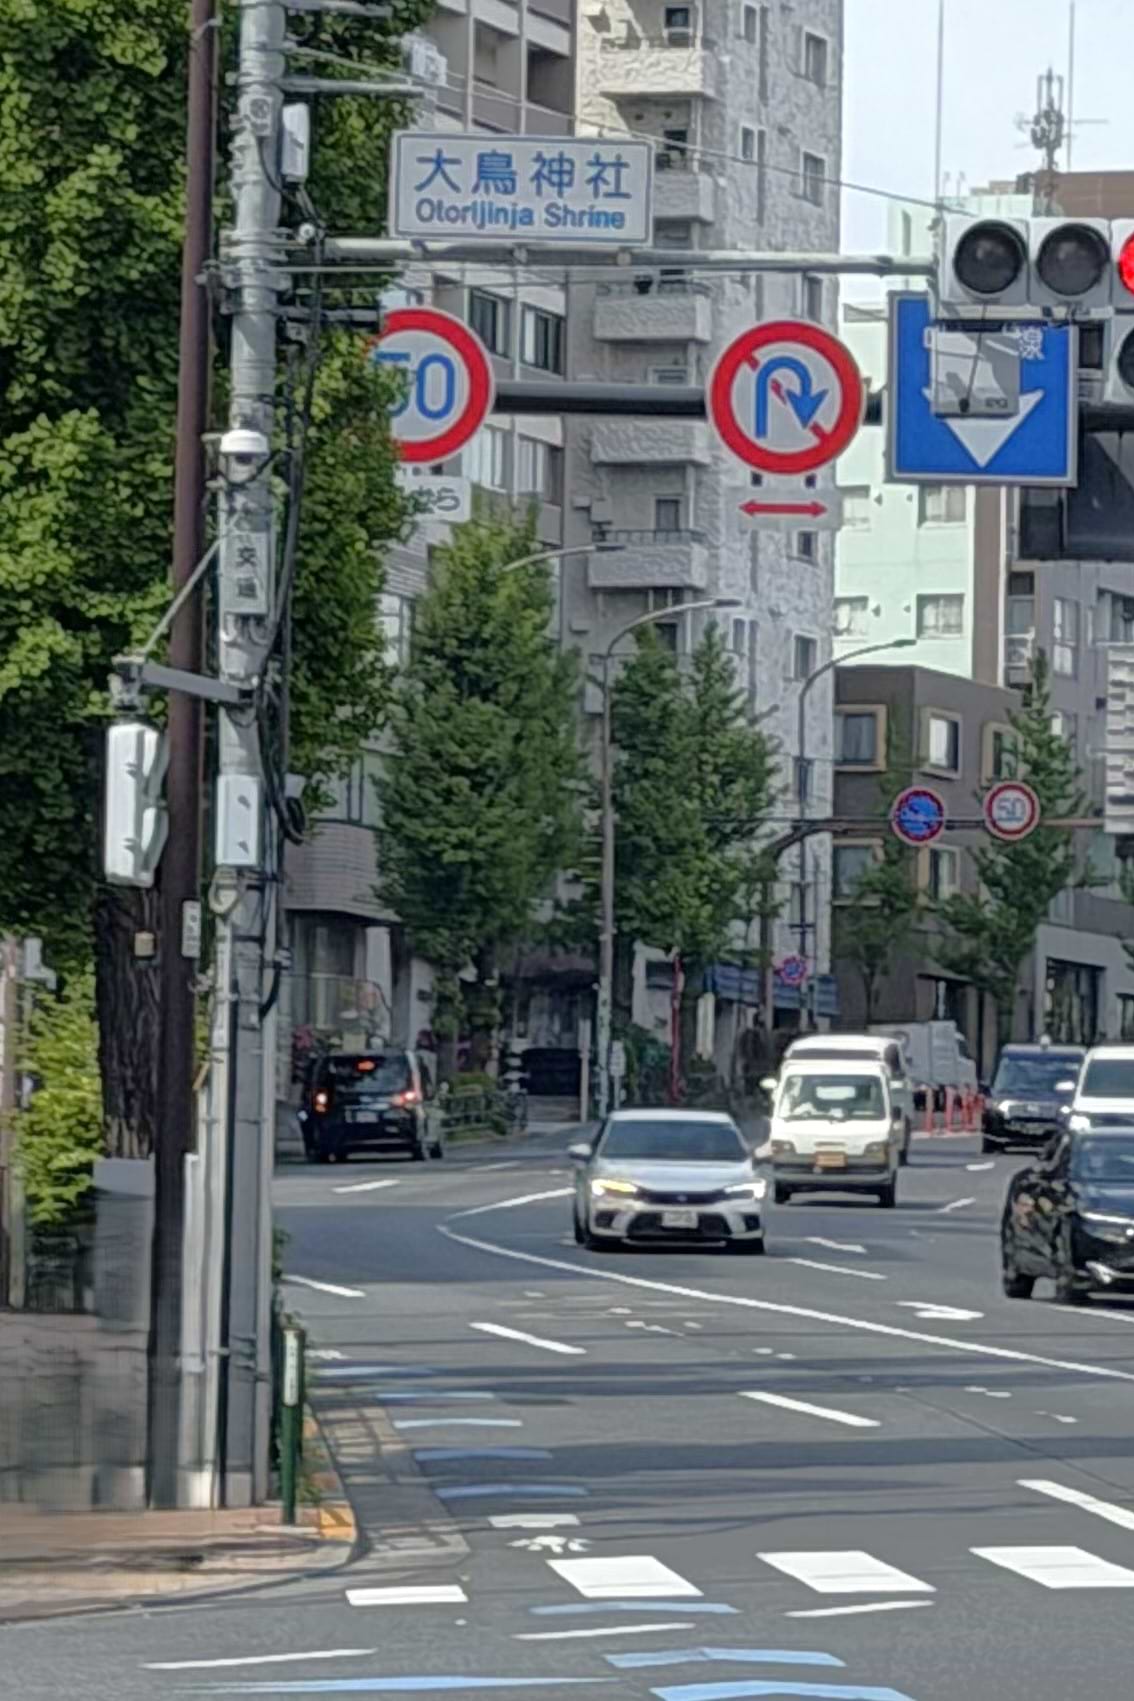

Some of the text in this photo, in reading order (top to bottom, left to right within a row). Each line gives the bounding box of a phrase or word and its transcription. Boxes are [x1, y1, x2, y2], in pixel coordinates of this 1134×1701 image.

[414, 148, 633, 200] 大鳥神社
[415, 197, 627, 230] Otorijinja Shrine
